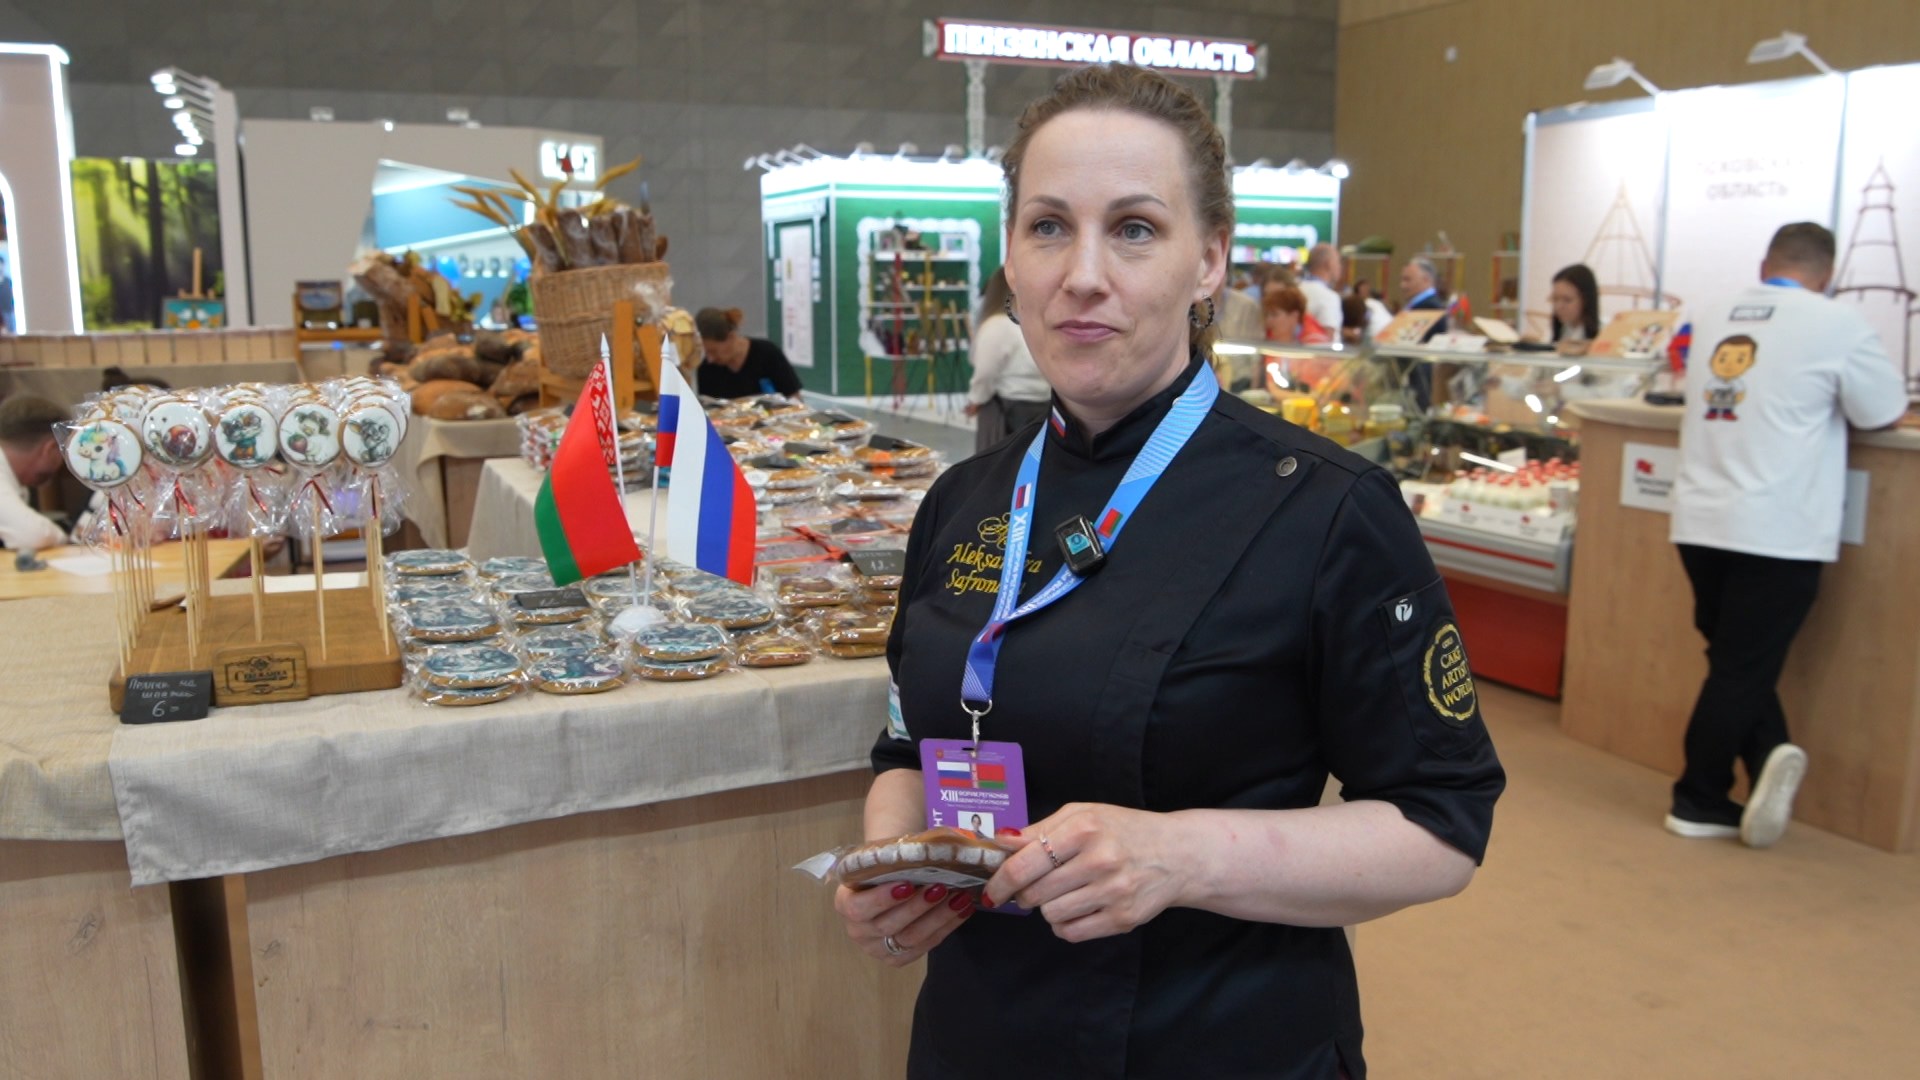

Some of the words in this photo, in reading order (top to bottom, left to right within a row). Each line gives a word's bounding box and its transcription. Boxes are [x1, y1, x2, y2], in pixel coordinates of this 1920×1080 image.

[945, 24, 1129, 62] ПЕНЗЕНСКАЯ
[1133, 38, 1254, 71] ОБЛАСТЬ
[940, 789, 958, 802] XIII
